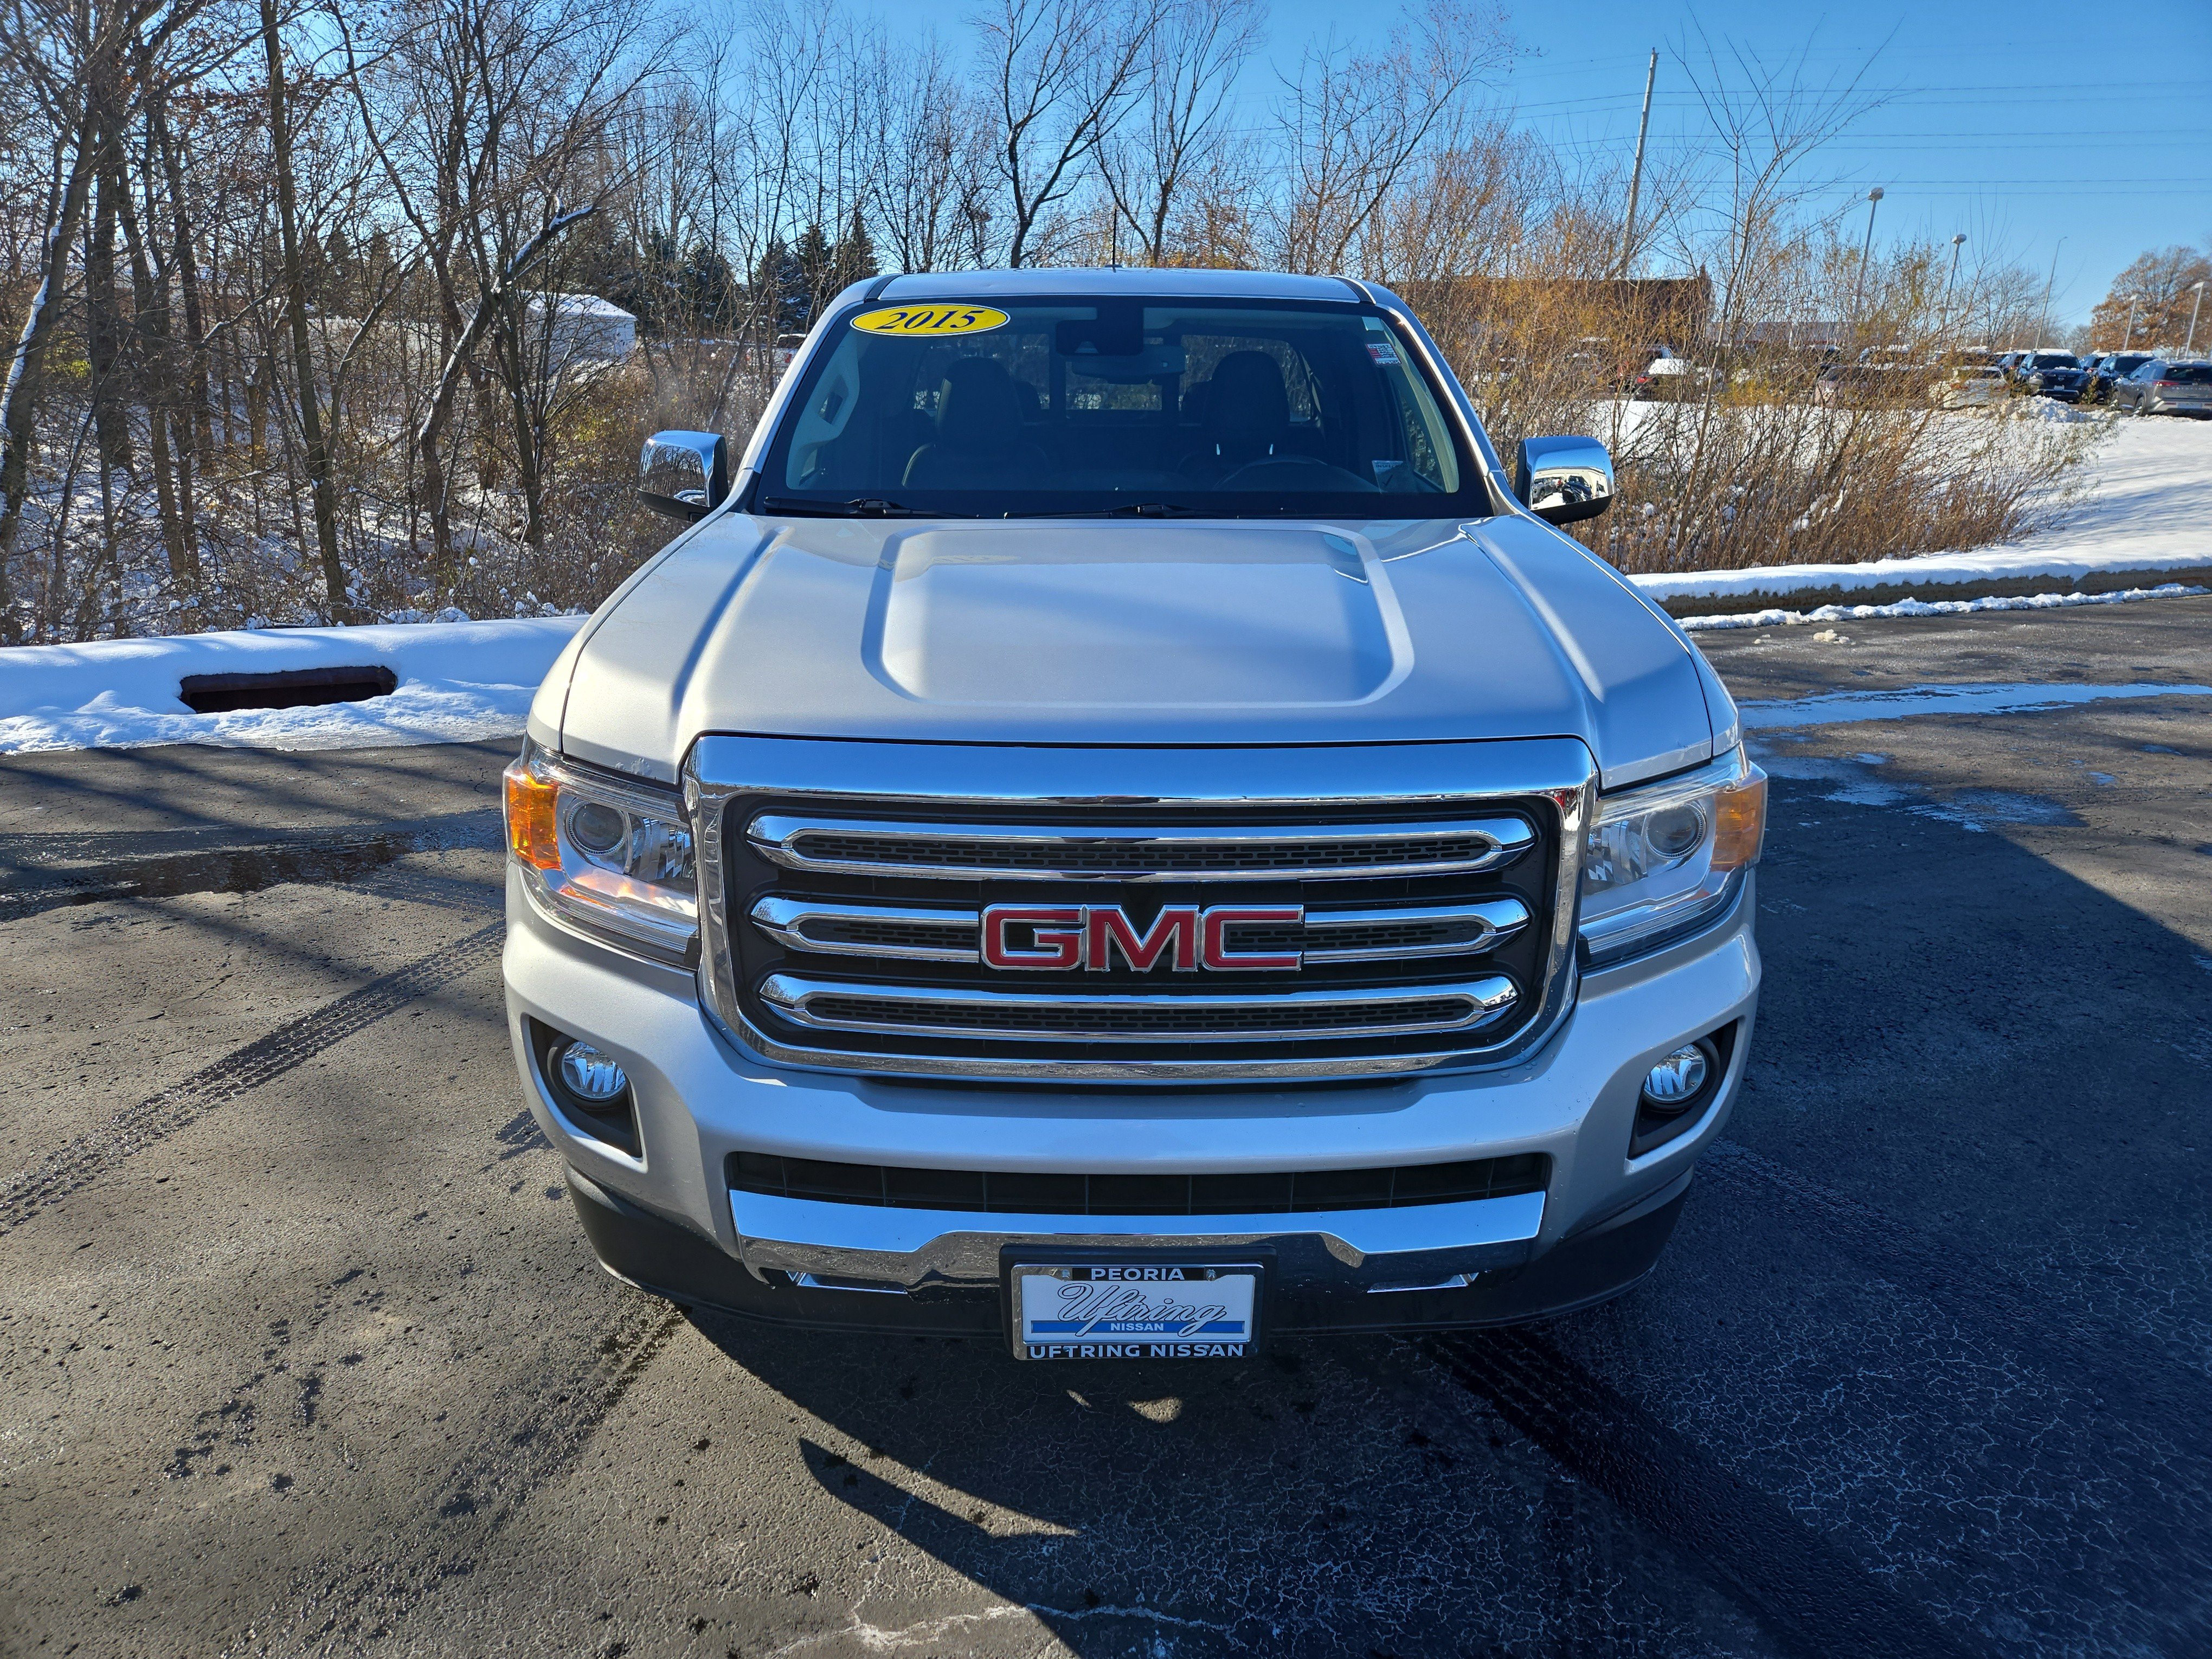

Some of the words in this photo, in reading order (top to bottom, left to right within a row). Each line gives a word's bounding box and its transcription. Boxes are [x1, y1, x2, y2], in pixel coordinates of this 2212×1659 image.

[874, 310, 986, 330] 2015
[981, 904, 1303, 972] GMC
[1091, 1268, 1185, 1281] PEORIA
[1057, 1283, 1227, 1337] Uftring
[1110, 1322, 1164, 1332] NISSAN
[1030, 1345, 1140, 1359] UFTRING
[1150, 1345, 1243, 1357] NISSAN
